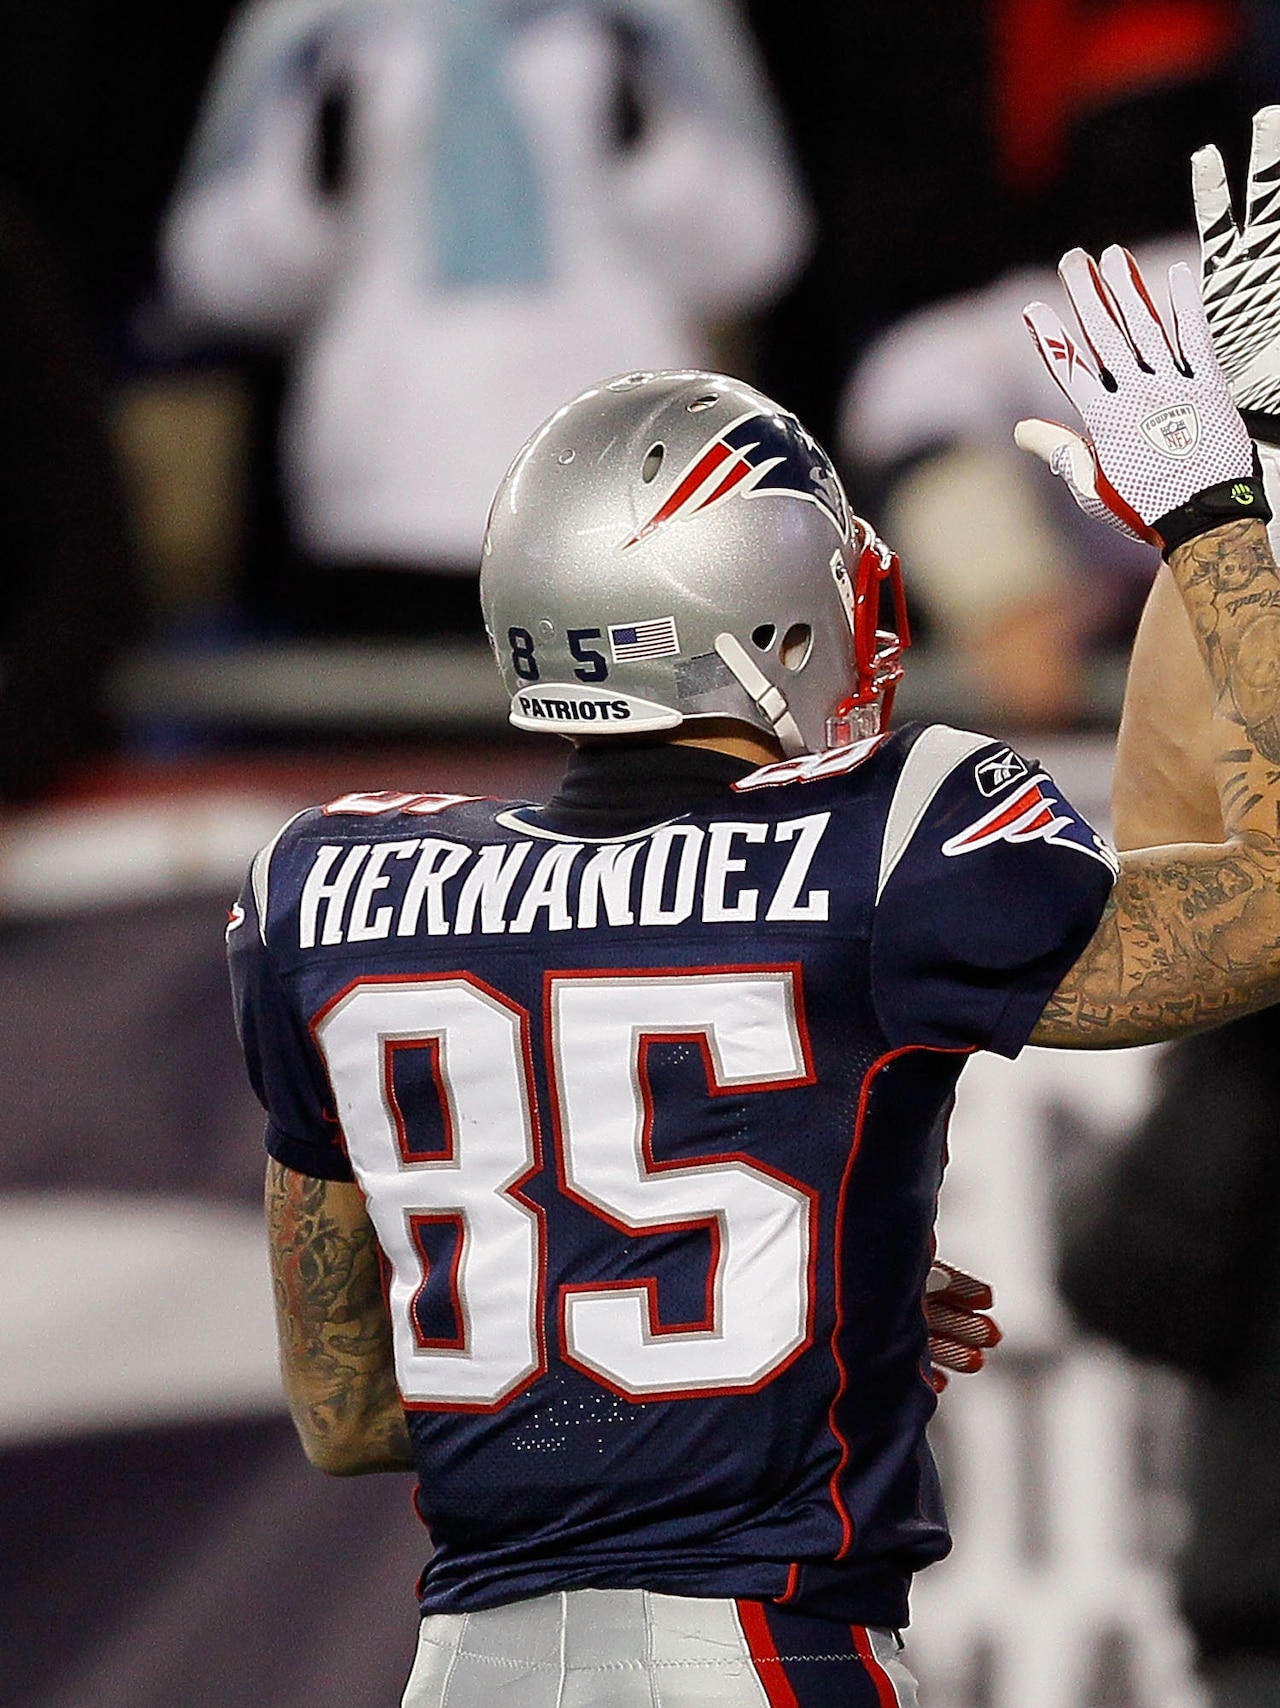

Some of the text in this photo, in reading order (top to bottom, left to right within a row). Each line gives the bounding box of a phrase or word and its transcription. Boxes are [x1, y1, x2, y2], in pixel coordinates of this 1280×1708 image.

[1145, 406, 1192, 431] EQUIPMENT
[1166, 430, 1193, 449] NFL
[519, 697, 631, 720] PATRIOTS
[299, 811, 832, 949] HERNANDEZ
[308, 962, 819, 1415] 85
